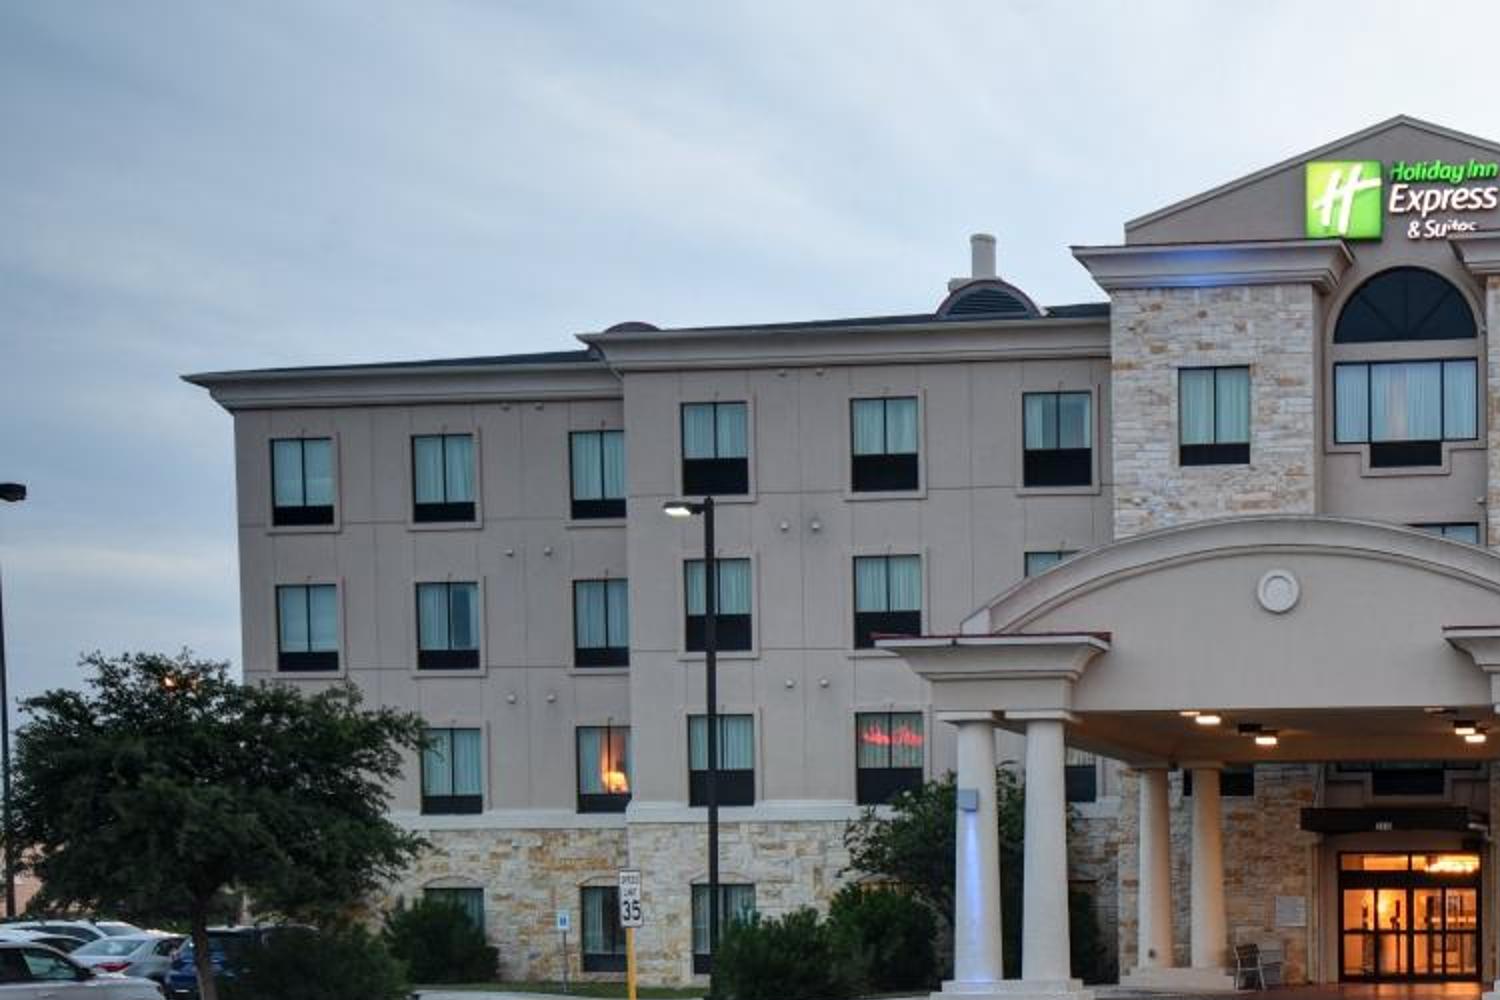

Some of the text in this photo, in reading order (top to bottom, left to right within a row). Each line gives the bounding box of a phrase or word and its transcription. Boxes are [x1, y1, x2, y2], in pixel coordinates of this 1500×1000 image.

[1391, 158, 1499, 184] Holiday Inn
[1388, 183, 1499, 218] Express
[1407, 220, 1420, 239] &
[623, 900, 641, 921] 35
